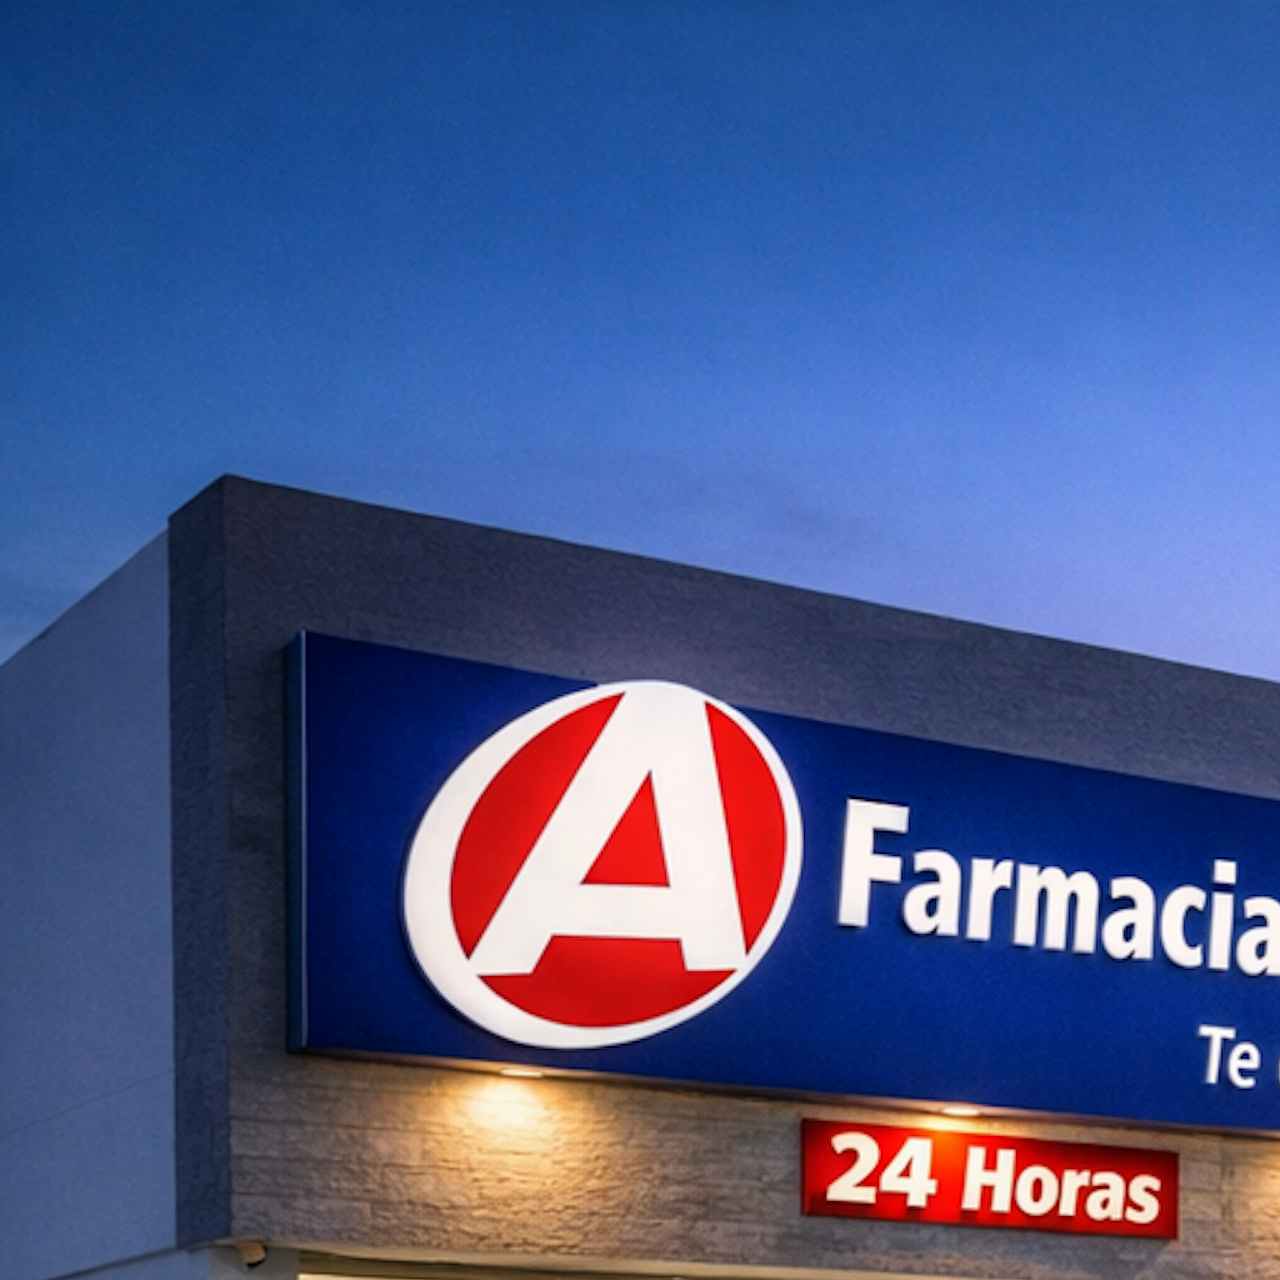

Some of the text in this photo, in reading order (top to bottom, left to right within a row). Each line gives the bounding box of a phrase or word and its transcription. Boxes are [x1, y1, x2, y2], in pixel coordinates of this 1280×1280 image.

[1199, 1025, 1261, 1088] Te
[826, 1131, 1161, 1224] 24 Horas
